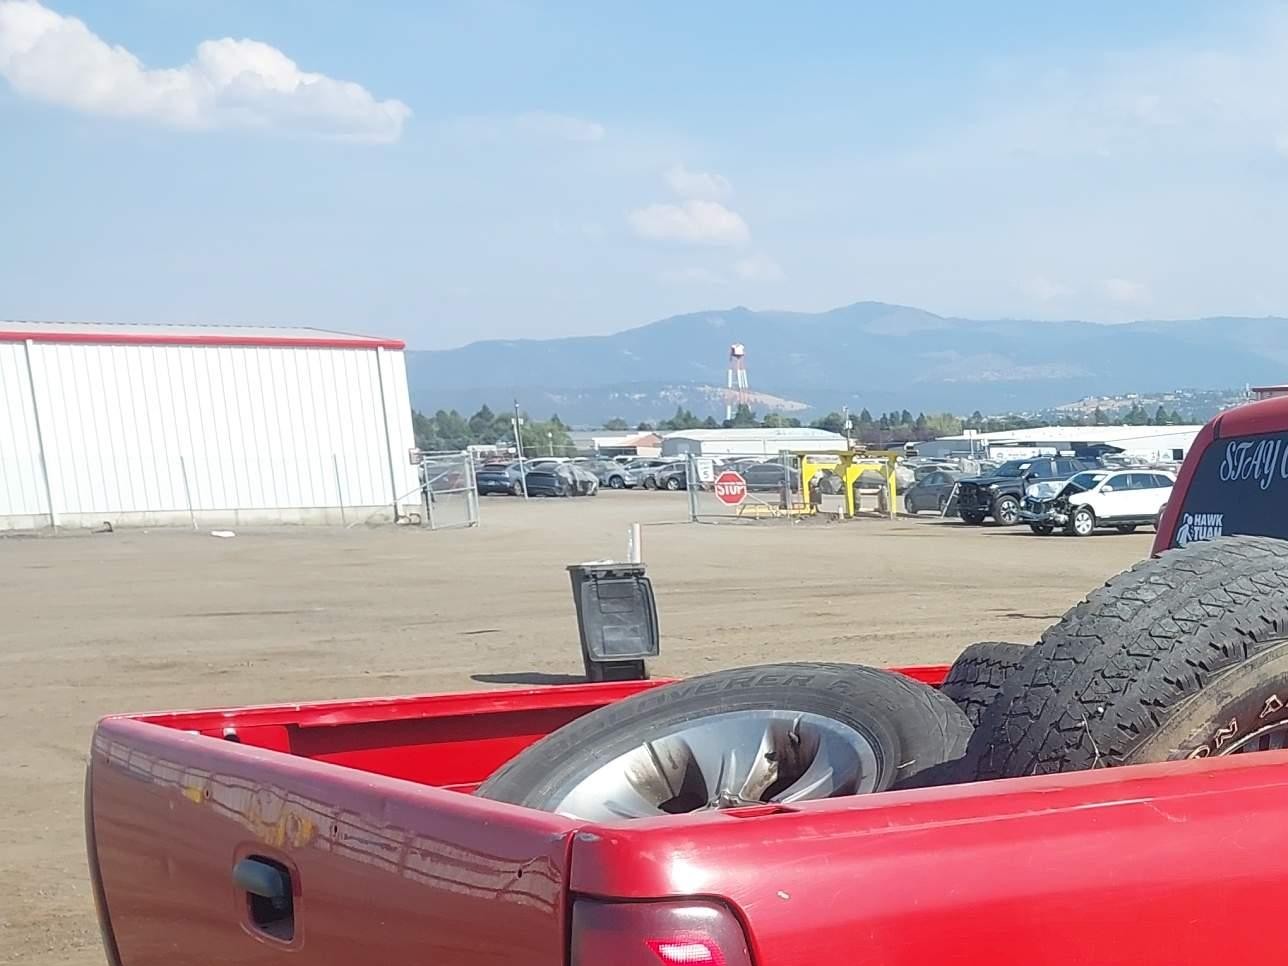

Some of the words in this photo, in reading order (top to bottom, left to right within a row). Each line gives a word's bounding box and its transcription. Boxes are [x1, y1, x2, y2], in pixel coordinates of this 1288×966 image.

[1220, 440, 1281, 490] STAY
[718, 482, 744, 496] STOP
[1193, 513, 1224, 527] HAWK
